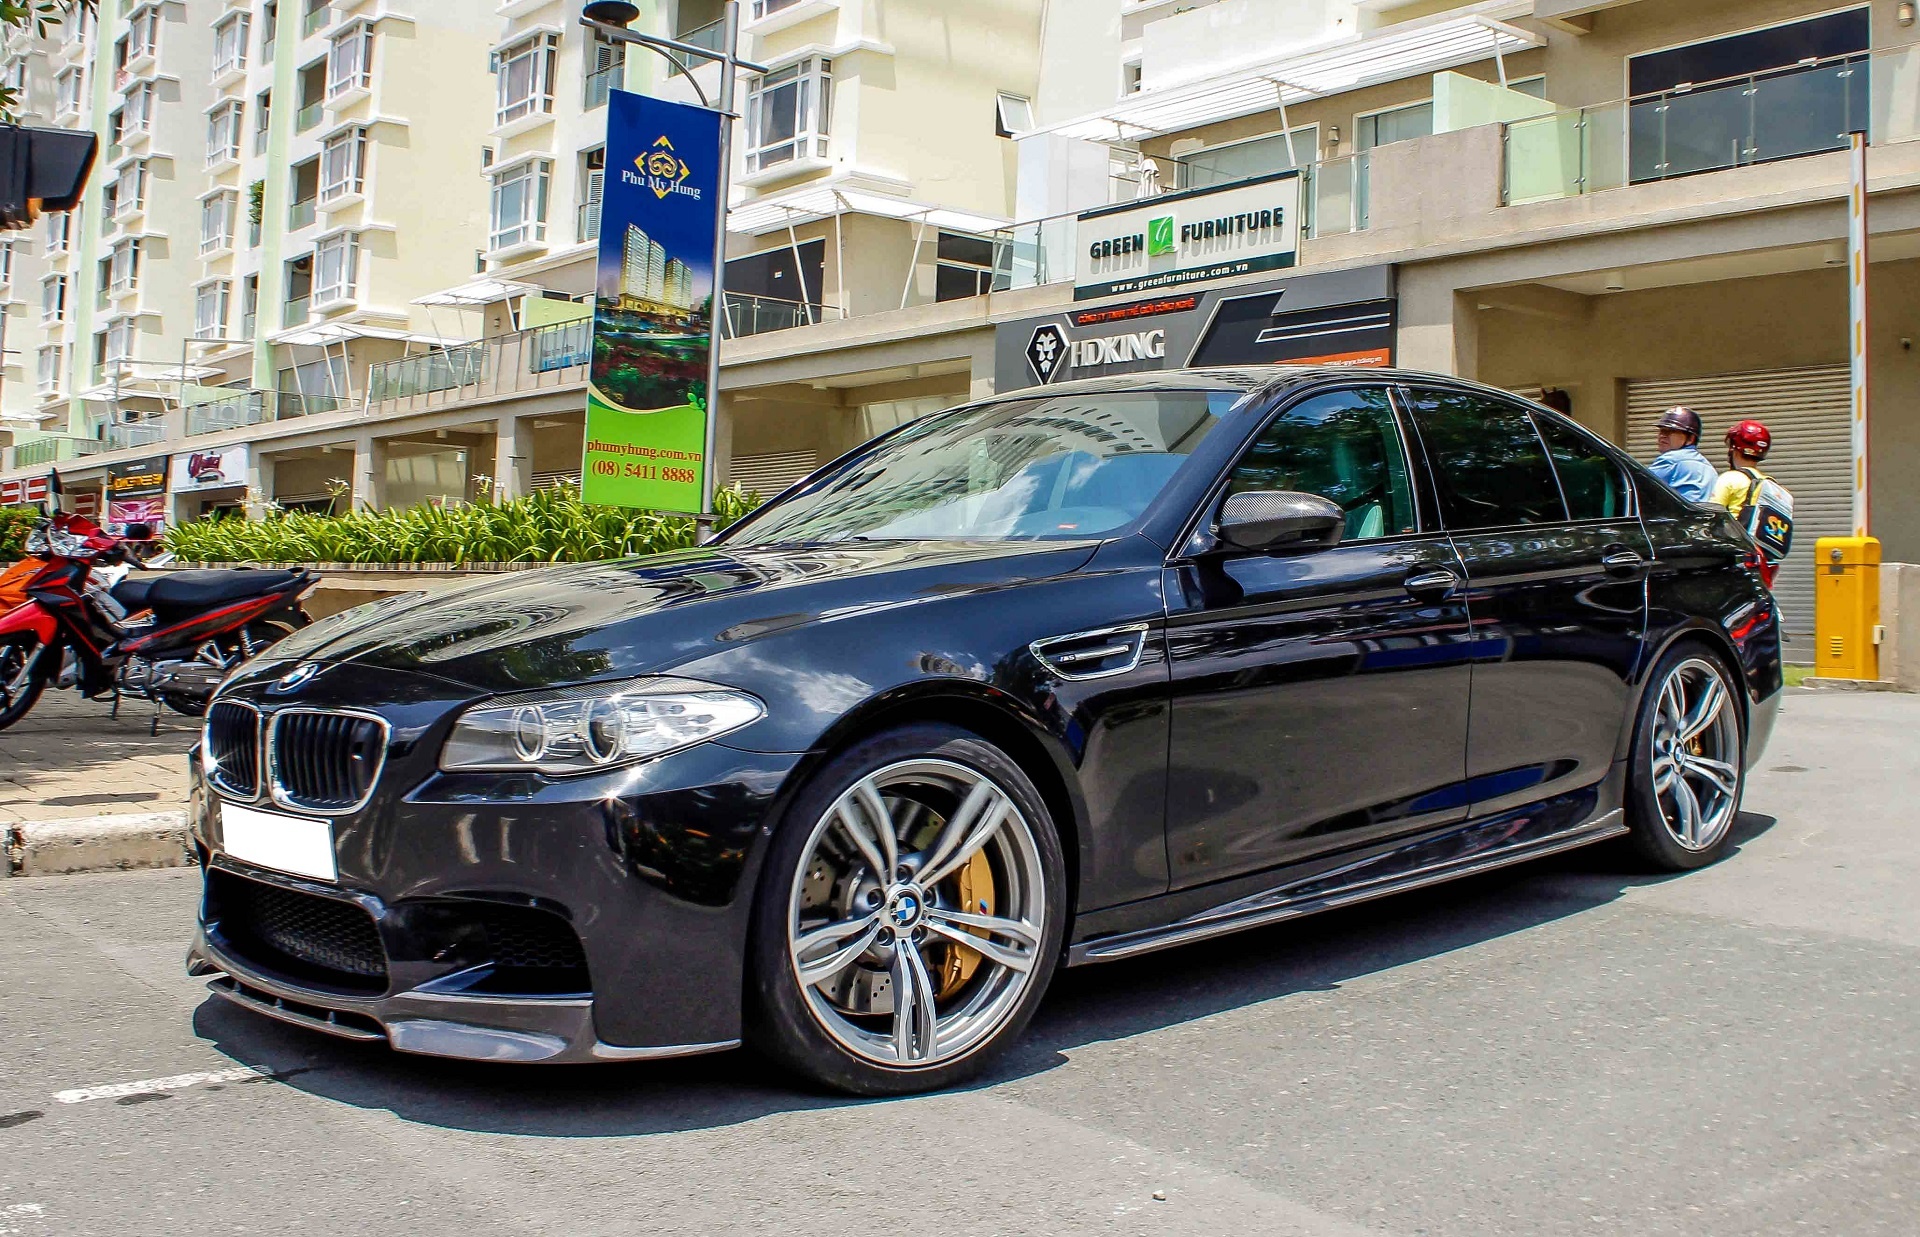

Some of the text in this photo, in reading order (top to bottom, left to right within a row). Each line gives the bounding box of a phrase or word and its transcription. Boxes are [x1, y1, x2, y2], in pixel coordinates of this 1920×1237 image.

[622, 170, 645, 186] Phu
[670, 180, 701, 200] Hung
[1090, 207, 1284, 259] GREEN FURNITURE
[1111, 263, 1249, 293] www.greenfurniture.com.vn
[1070, 329, 1165, 368] HDKING
[586, 439, 702, 461] phumyhung.com.vn
[592, 460, 695, 484] (08) 5411 8888
